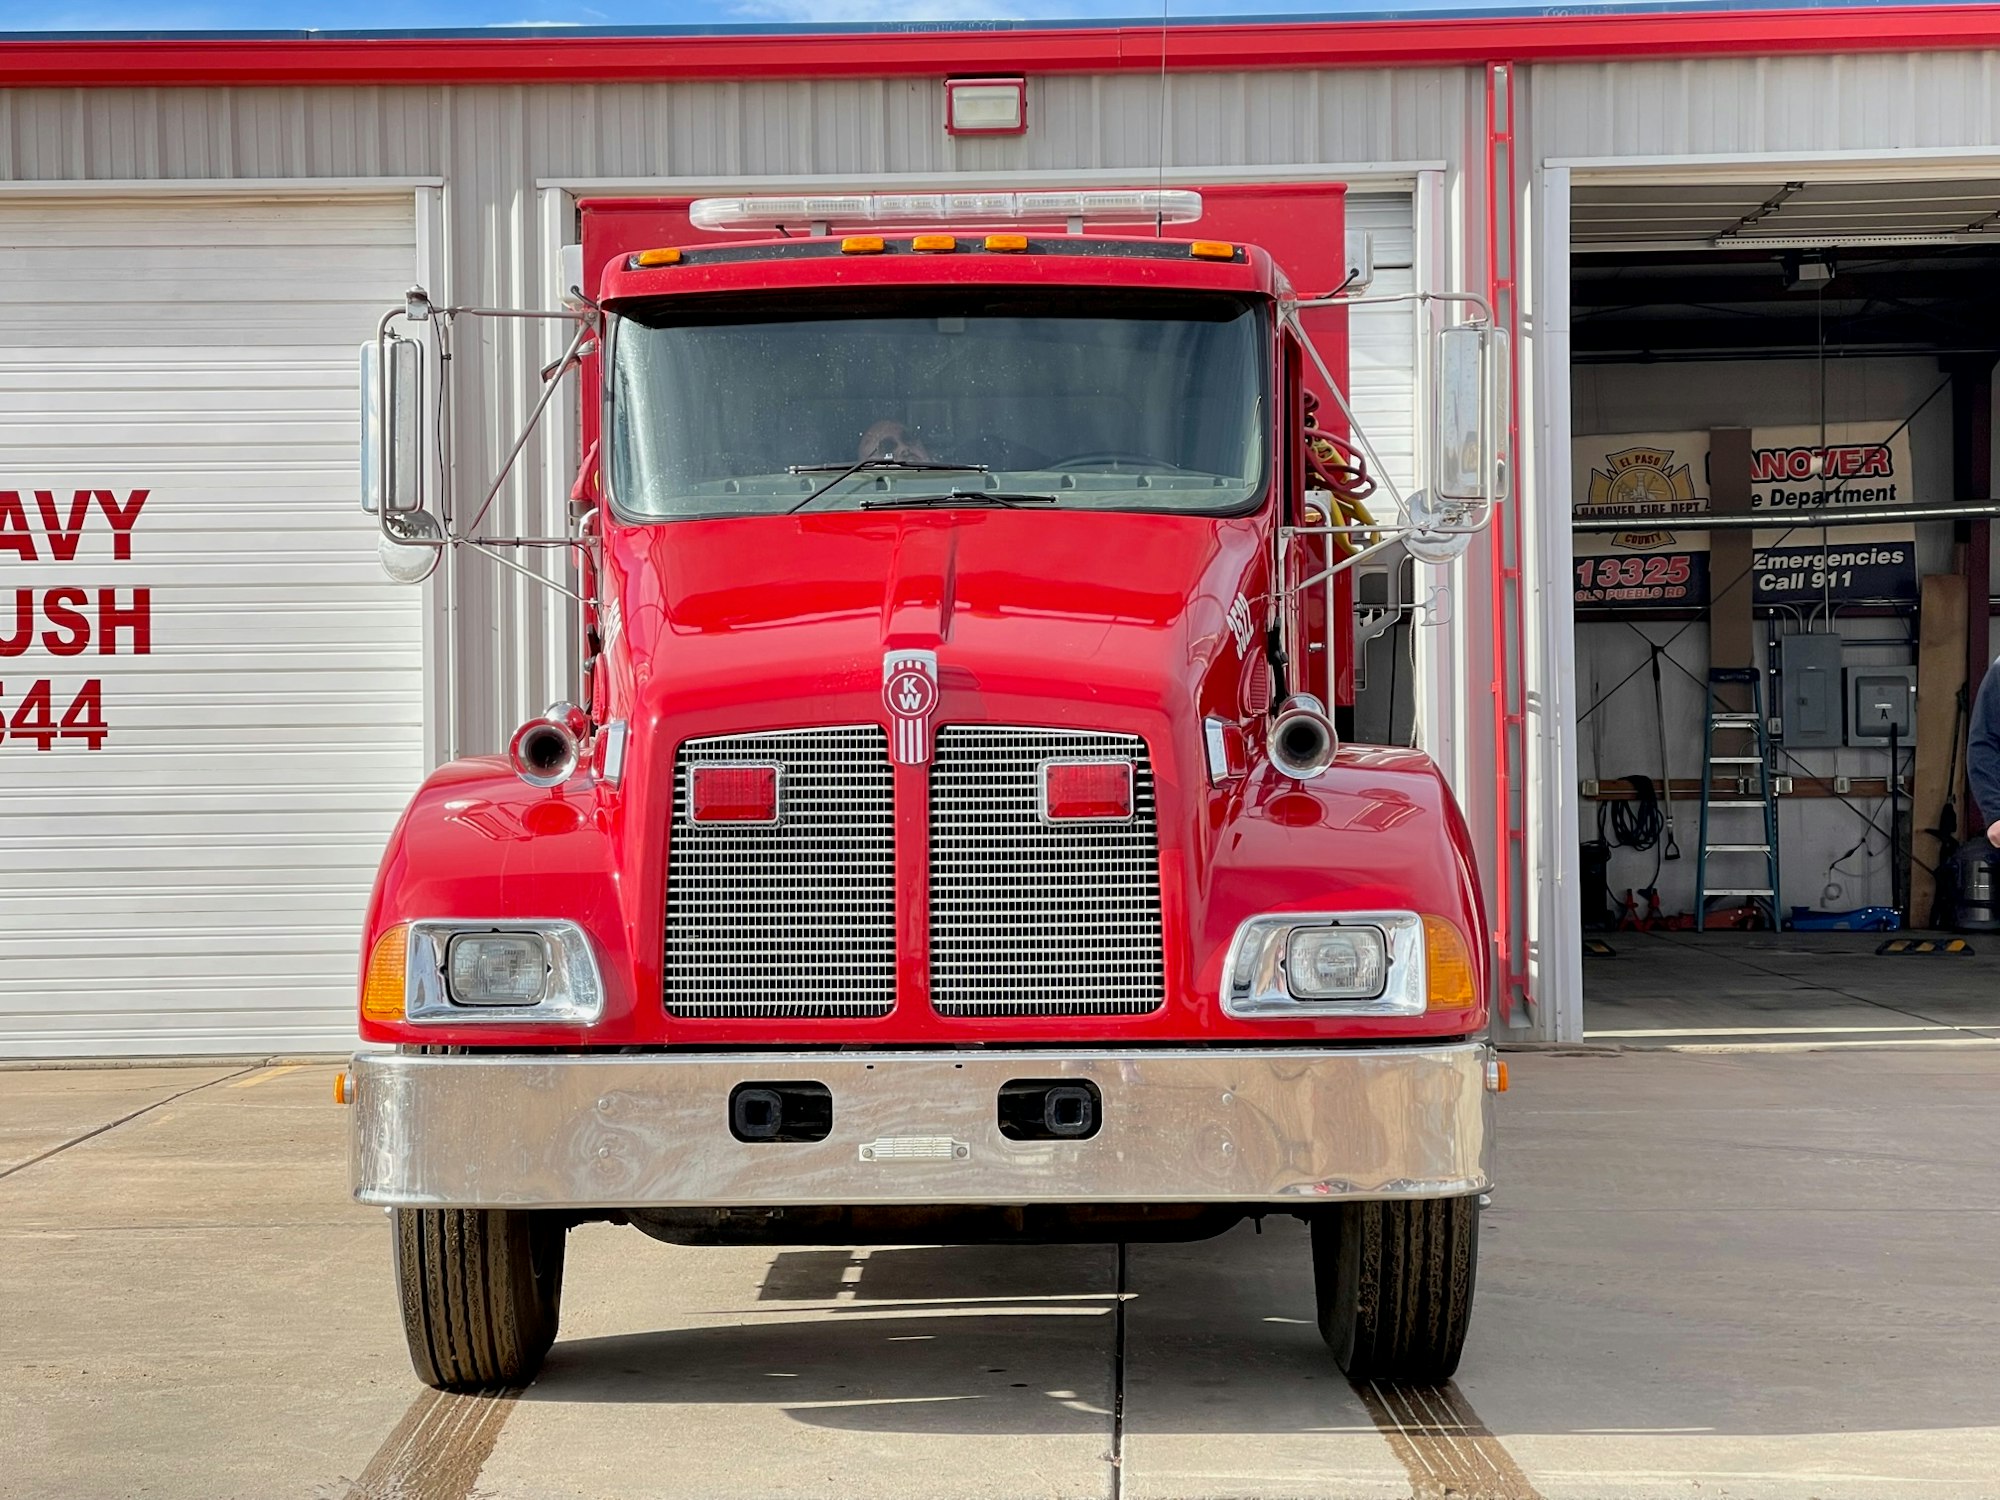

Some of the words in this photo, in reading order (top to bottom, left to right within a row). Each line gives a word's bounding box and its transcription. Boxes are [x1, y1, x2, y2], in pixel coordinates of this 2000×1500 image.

[1620, 457, 1632, 467] EL
[1635, 454, 1661, 466] PASO
[1770, 484, 1896, 509] Department
[0, 490, 150, 561] AVY
[1625, 533, 1662, 545] COUNTY
[1752, 548, 1904, 571] Emergencies
[1577, 556, 1690, 588] 13325
[1759, 573, 1805, 591] Call
[1811, 570, 1852, 588] 911
[1606, 587, 1663, 600] PUEBLO
[1665, 586, 1686, 598] RD
[0, 587, 150, 657] USH
[0, 679, 108, 751] 44
